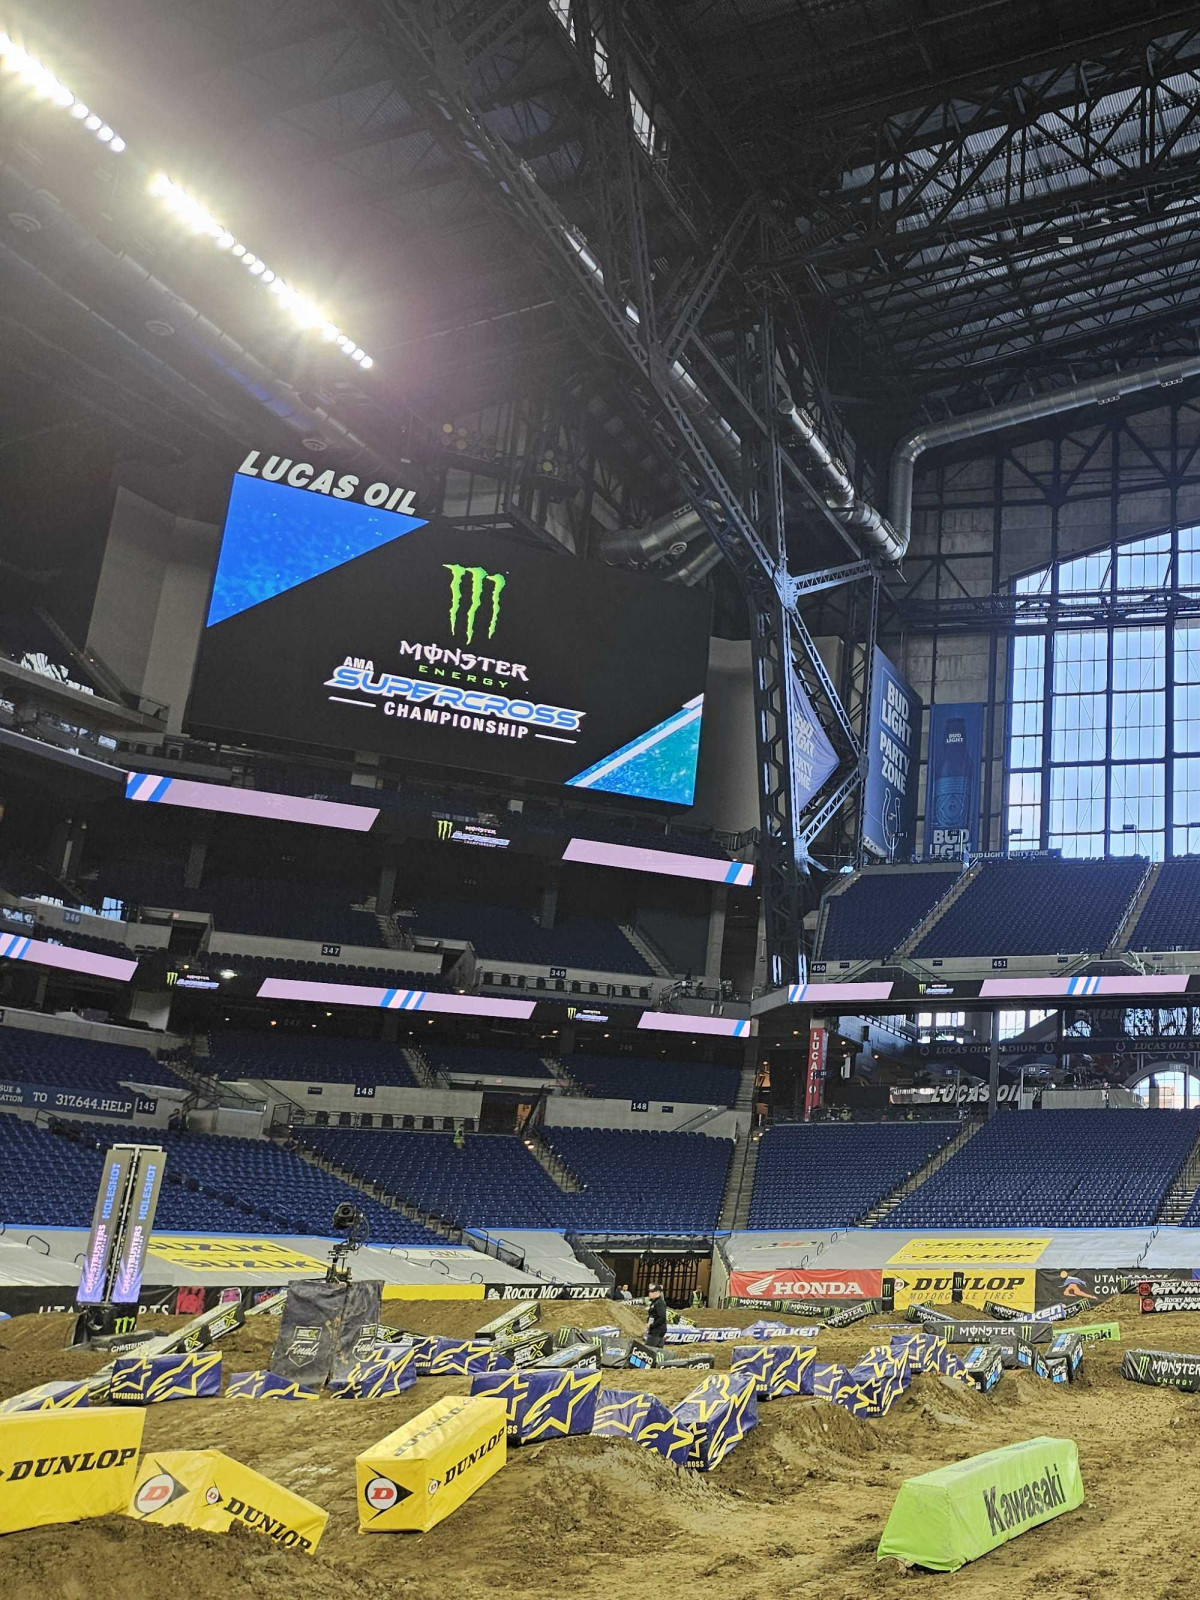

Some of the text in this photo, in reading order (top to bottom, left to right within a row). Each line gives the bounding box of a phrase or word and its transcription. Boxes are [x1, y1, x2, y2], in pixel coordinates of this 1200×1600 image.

[239, 450, 418, 515] LUCAS OIL
[343, 656, 374, 672] AMA
[400, 640, 530, 682] MONSTER
[418, 664, 509, 689] ENERGY
[323, 665, 587, 731] SUPERCROSS
[886, 680, 910, 720] BUD
[384, 701, 529, 739] CHAMPIONSHIP
[881, 703, 912, 747] LIGHT
[879, 731, 911, 775] PARTY
[881, 756, 906, 796] ZONE
[65, 913, 80, 923] 346
[322, 946, 340, 954] 347
[812, 963, 826, 972] 450
[992, 960, 1006, 968] 451
[551, 969, 566, 977] 349
[1133, 1042, 1166, 1051] LUCAS
[1168, 1041, 1186, 1050] OIL
[33, 1092, 48, 1103] TO
[355, 1087, 374, 1096] 148
[931, 1084, 990, 1103] LUCAS
[138, 1101, 155, 1112] 145
[632, 1102, 647, 1110] 148
[102, 1162, 121, 1219] HOLESHOT
[139, 1163, 156, 1220] HOLESHOT
[171, 1258, 332, 1269] SUZUKI
[503, 1285, 539, 1300] ROCKY
[773, 1281, 863, 1295] HONDA
[984, 1292, 1014, 1300] TIRES
[702, 1330, 741, 1340] FALKEN
[764, 1327, 819, 1337] FALKEN
[959, 1326, 1016, 1337] MONSTER
[285, 1342, 319, 1356] Finals
[633, 1347, 653, 1365] GoPro
[1157, 1377, 1193, 1386] ENERGY
[112, 1392, 145, 1400] SUPERCROSS
[444, 1426, 505, 1487] DUNLOP
[6, 1448, 137, 1482] DUNLOP
[145, 1485, 170, 1501] D
[371, 1487, 394, 1499] D
[983, 1464, 1066, 1537] Kawasaki
[224, 1496, 313, 1552] DUNLOP
